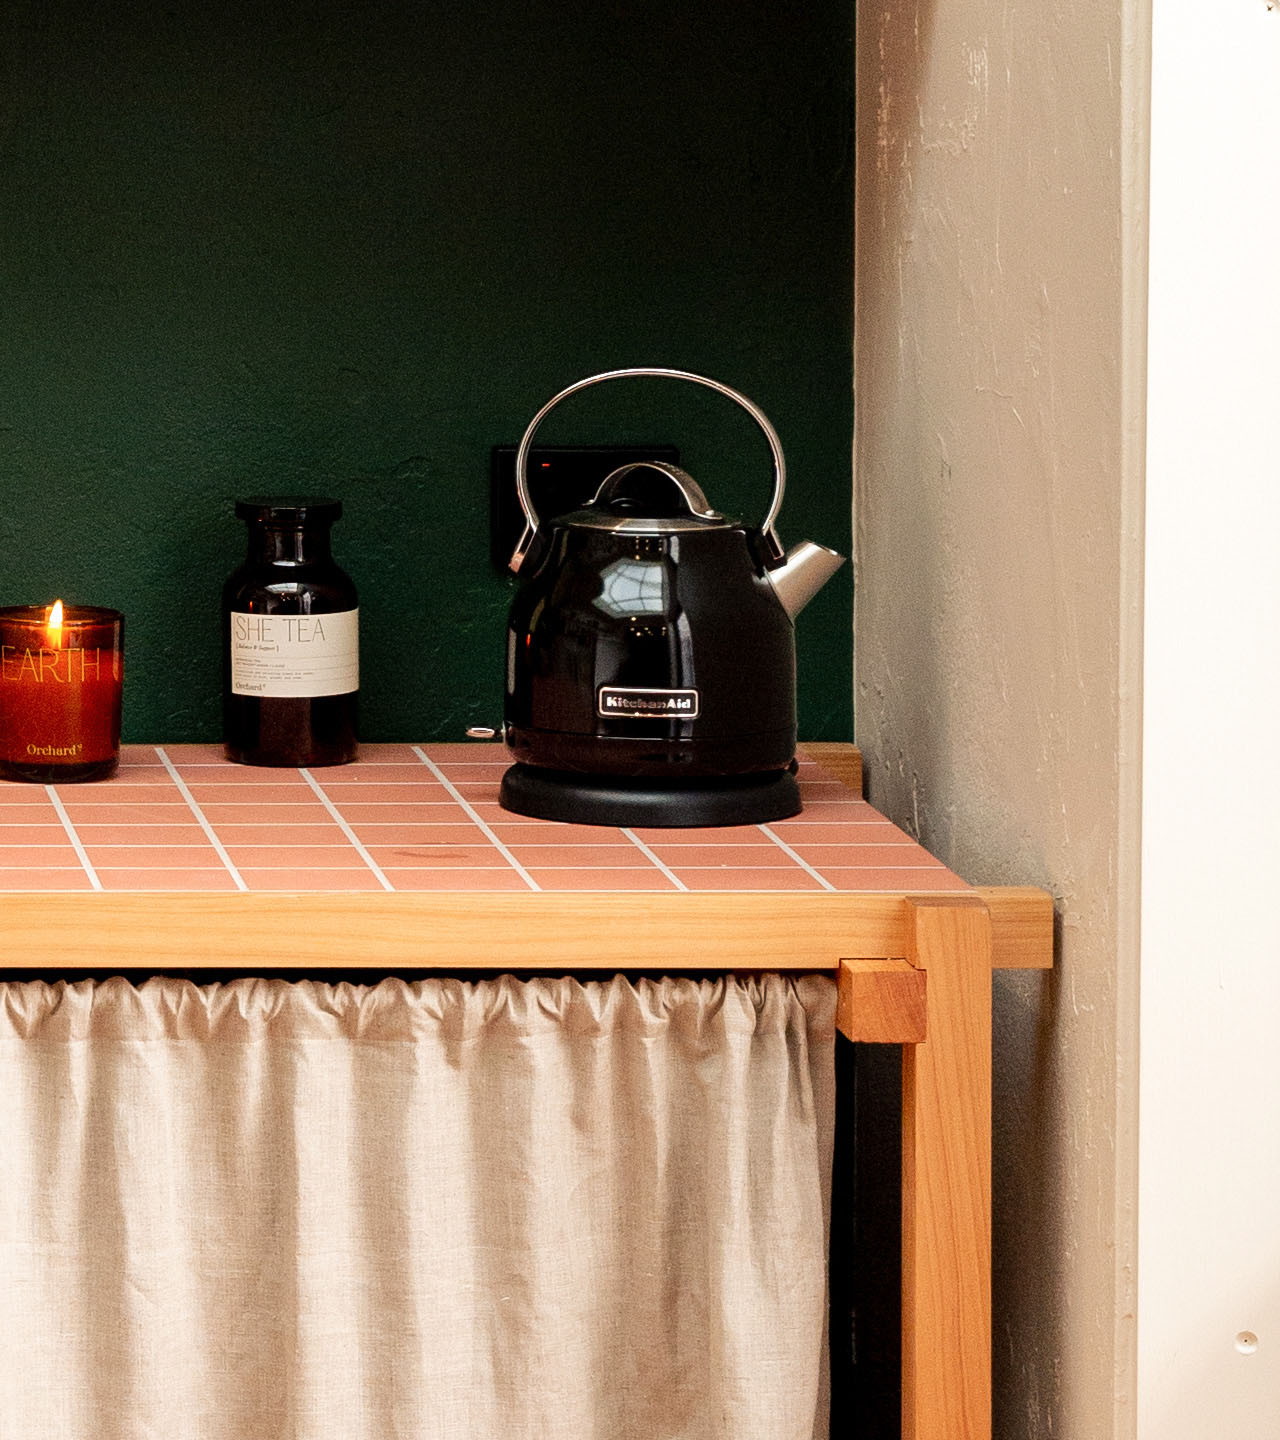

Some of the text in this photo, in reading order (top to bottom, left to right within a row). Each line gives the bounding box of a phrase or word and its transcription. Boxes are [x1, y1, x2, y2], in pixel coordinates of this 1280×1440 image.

[235, 616, 326, 642] SHE TEA
[1, 645, 100, 683] EARTH
[606, 696, 691, 709] KitchenAid
